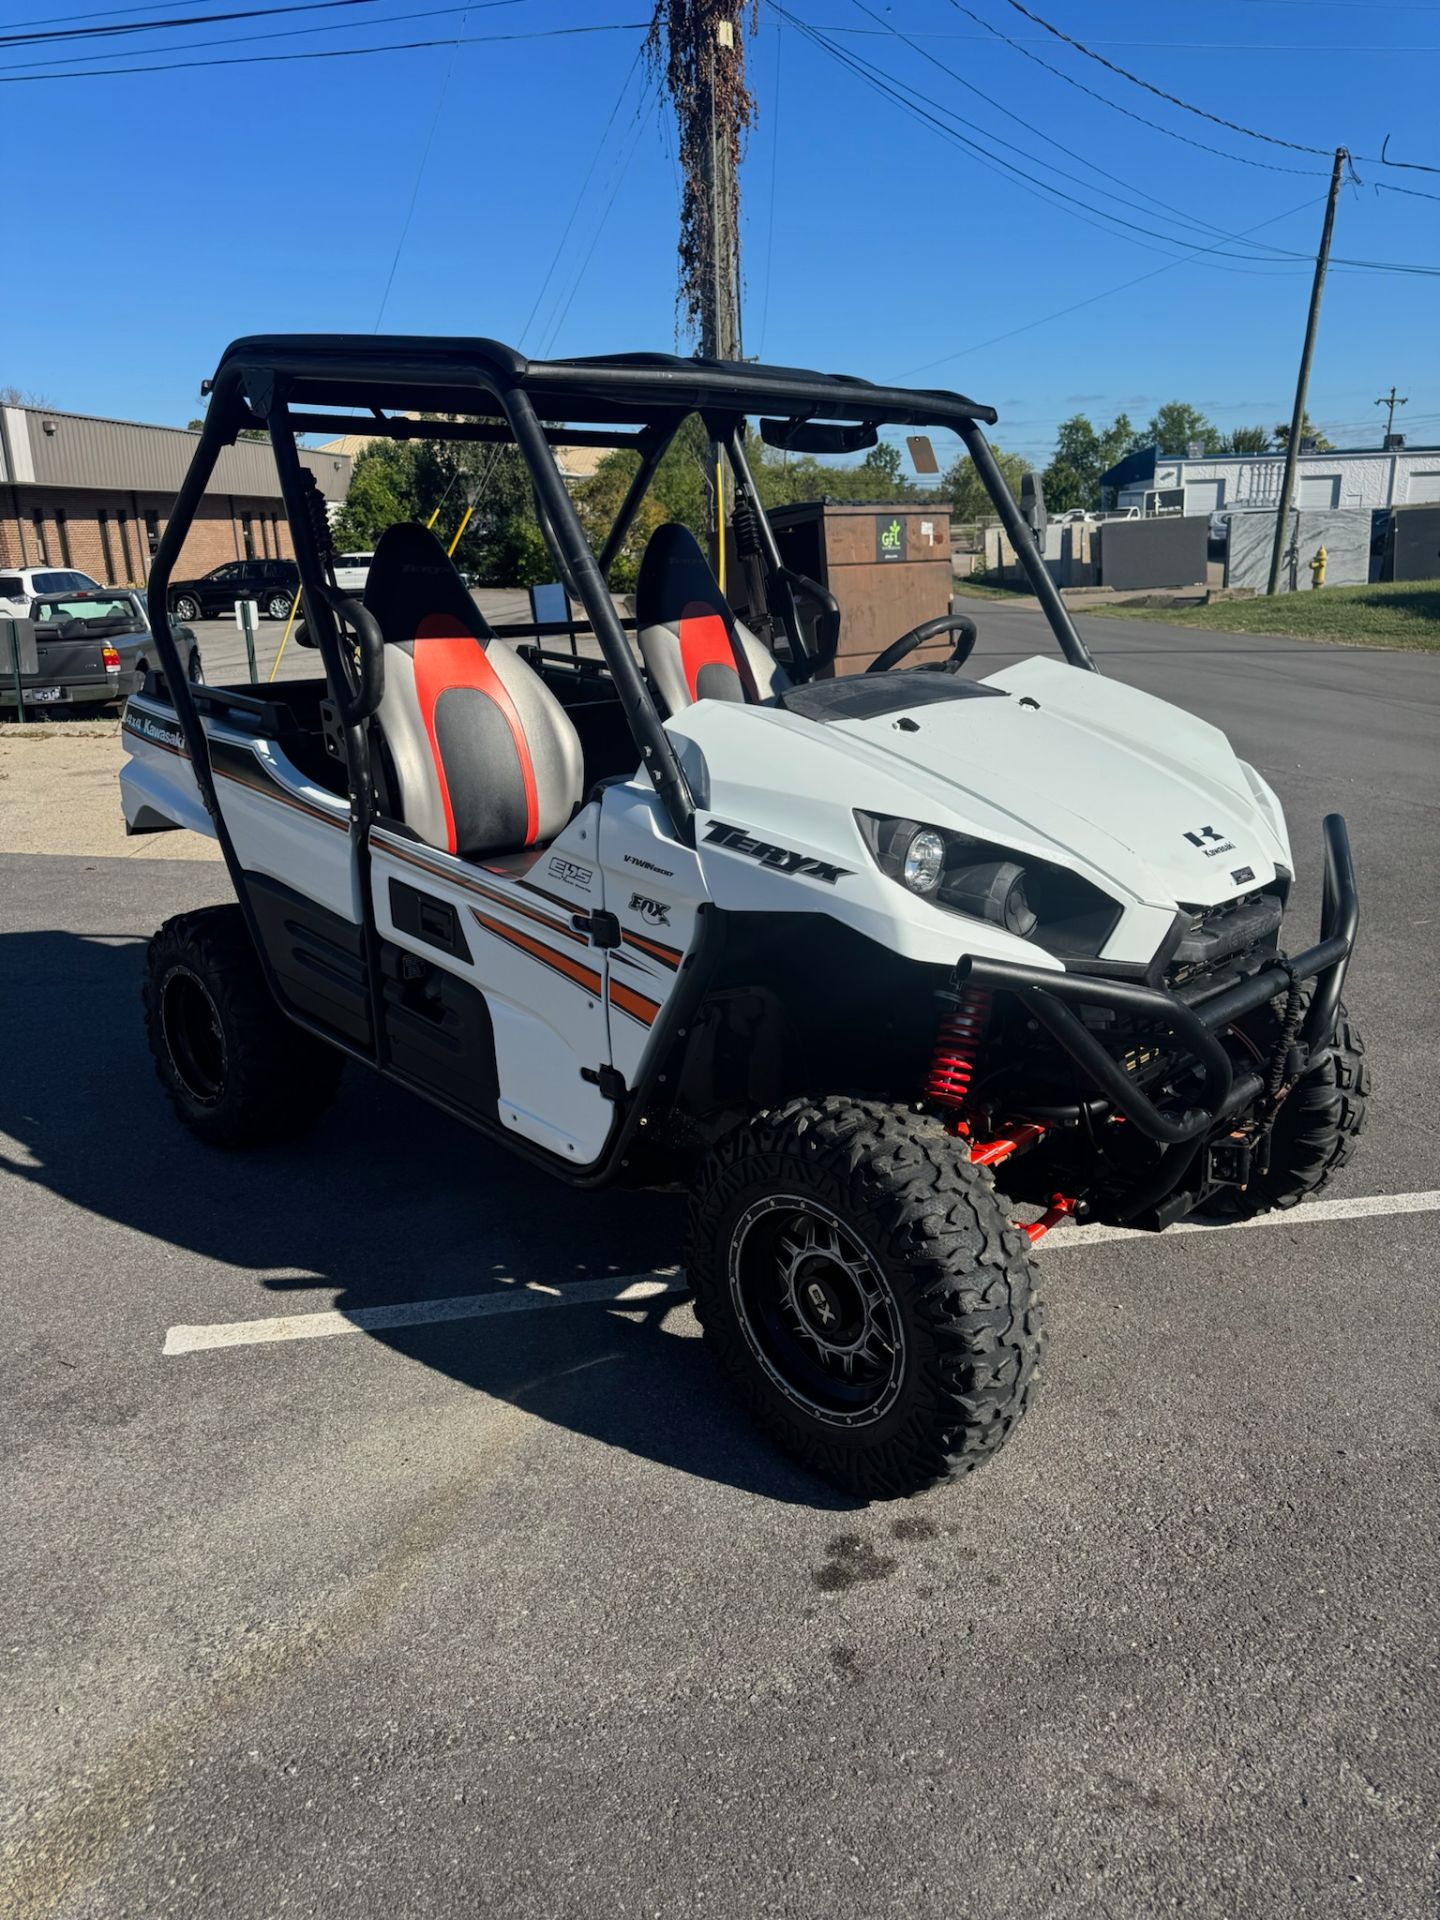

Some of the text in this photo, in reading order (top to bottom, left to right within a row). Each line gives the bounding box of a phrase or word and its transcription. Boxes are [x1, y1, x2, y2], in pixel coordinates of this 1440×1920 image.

[881, 528, 901, 546] GFL
[126, 714, 186, 749] 4x4 Kawasaki
[702, 819, 859, 885] TERYX
[1202, 841, 1237, 858] Kawasaki
[548, 857, 593, 885] EPS
[629, 892, 670, 918] FOX
